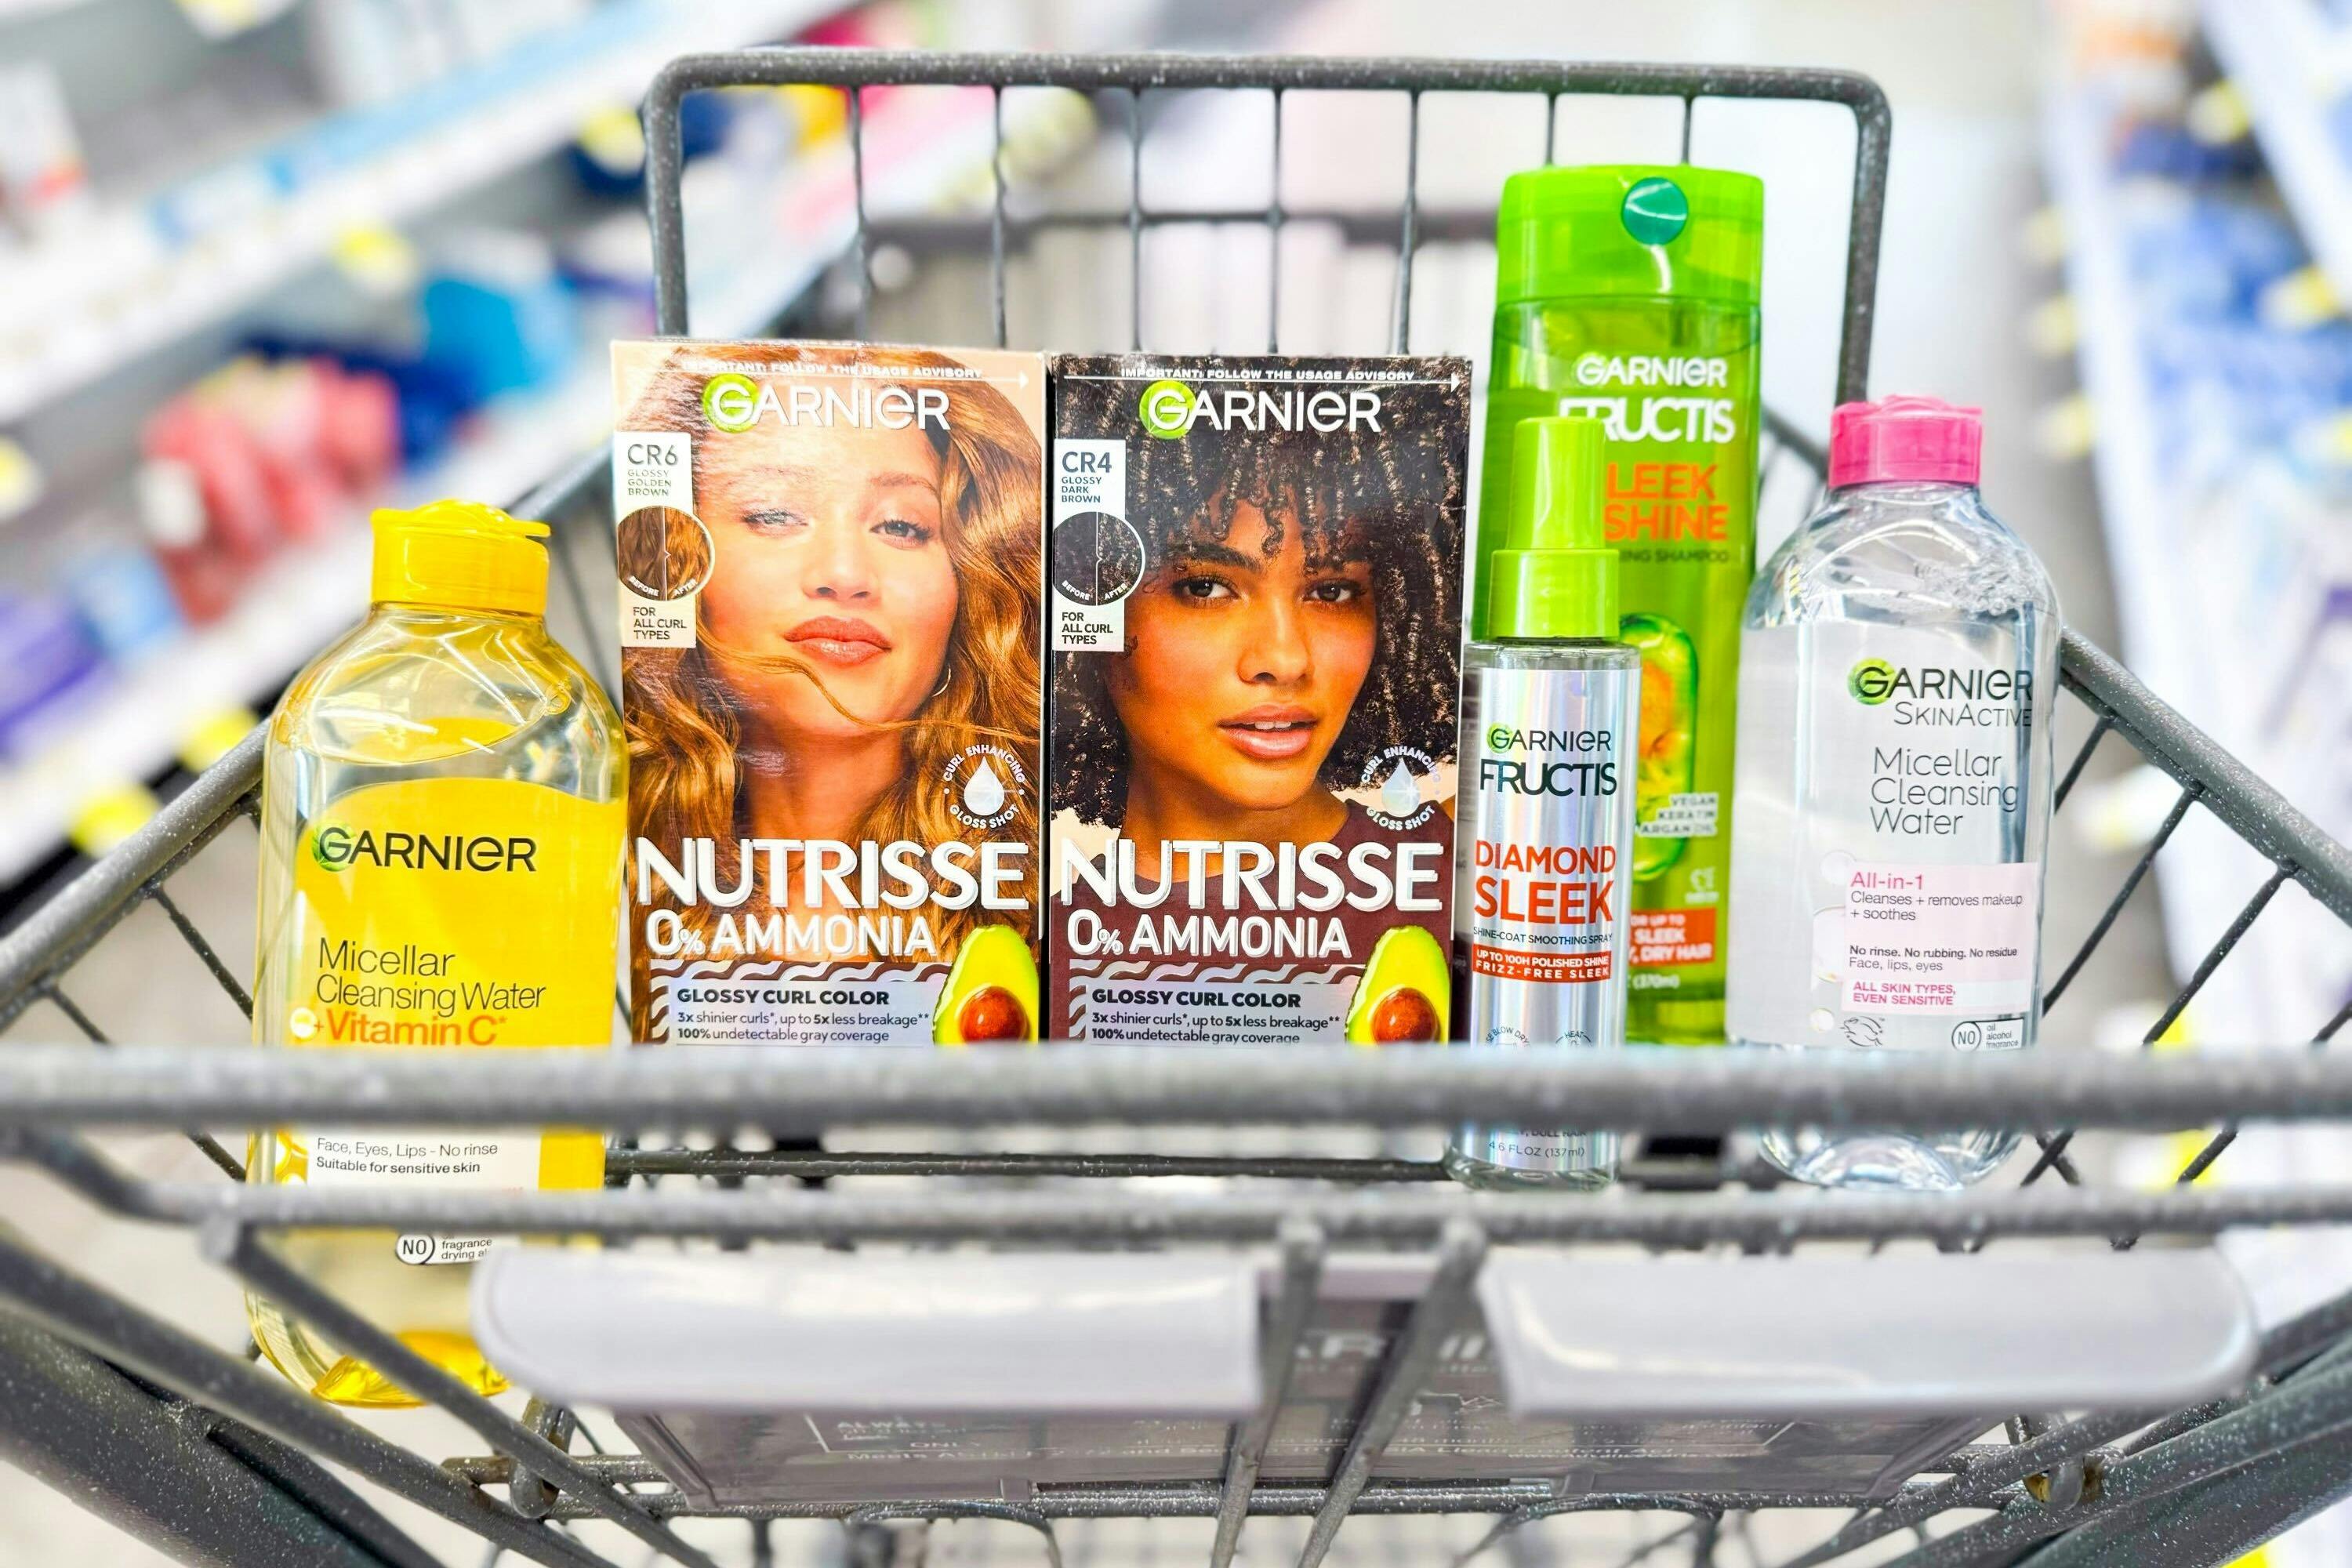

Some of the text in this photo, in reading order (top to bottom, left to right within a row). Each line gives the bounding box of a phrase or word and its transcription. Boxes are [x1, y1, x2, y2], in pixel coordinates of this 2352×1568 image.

[771, 362, 827, 374] FOLLOW
[832, 364, 858, 376] THE
[862, 365, 909, 377] USAGE
[913, 367, 982, 379] ADVISORY
[1207, 369, 1261, 379] FOLLOW
[1265, 370, 1292, 379] THE
[1296, 370, 1342, 379] USAGE
[1345, 371, 1414, 380] ADVISORY
[1577, 356, 1727, 387] GARNIER
[712, 383, 951, 430] GARNIER
[1149, 390, 1381, 433] GARNIER
[627, 444, 678, 466] CR6
[1062, 452, 1112, 474] CR4
[627, 469, 670, 477] GLOSSY
[1062, 476, 1102, 485] GLOSSY
[1607, 463, 1718, 500] LEEK
[627, 478, 672, 487] GOLDEN
[1062, 485, 1089, 494] DARK
[628, 488, 669, 496] BROWN
[1062, 495, 1101, 503] BROWN
[1605, 503, 1728, 541] SHINE
[628, 575, 659, 597] BEFORE
[673, 579, 697, 596] AFTER
[1062, 580, 1091, 601] BEFORE
[1104, 583, 1128, 601] AFTER
[633, 606, 656, 617] FOR
[1062, 612, 1083, 622] FOR
[633, 618, 687, 629] ALL CURL
[1062, 624, 1113, 633] ALL CURL
[633, 630, 670, 641] TYPES
[1062, 635, 1097, 644] TYPES
[1857, 666, 2032, 701] GARNIER
[1490, 728, 1612, 752] GARNIER
[943, 745, 1025, 782] CURL ENHANCING
[1361, 755, 1383, 783] CURL
[1874, 746, 2002, 776] Micellar
[1480, 758, 1617, 797] FRUCTIS
[1871, 777, 2019, 813] Cleansing
[949, 803, 1019, 829] GLOSS SHOT
[1367, 805, 1436, 831] GLOSS SHOT
[1870, 806, 1963, 835] Water
[319, 827, 536, 872] GARNIER
[1475, 840, 1616, 875] DIAMOND
[636, 837, 1029, 910] NUTRISSE
[1061, 837, 1444, 911] NUTRISSE
[1850, 871, 1925, 890] All-in-1
[1474, 875, 1614, 924] SLEEK
[1850, 891, 2023, 907] Cleanses removes makeup
[1850, 908, 1916, 920] + soothes
[645, 909, 938, 956] 0% AMMONIA
[1067, 908, 1352, 957] 0% AMMONIA
[1473, 926, 1613, 946] SHINE-COAT SMOOTHING SPRAY
[1635, 927, 1686, 944] SLEEK
[319, 937, 456, 977] Micellar
[1476, 949, 1610, 967] UP TO 100H POLISHED SHINE
[1640, 945, 1675, 962] DRY
[1676, 942, 1713, 961] HAIR
[1849, 945, 2018, 960] No rinse. No rubbing. No residue
[1475, 960, 1563, 978] FRIZZ-FREE
[1570, 966, 1609, 979] SLEEK
[1849, 957, 1943, 973] Face, lips, eyes
[316, 974, 546, 1018] Cleansing Water
[677, 988, 890, 1005] GLOSSY CURL COLOR
[1853, 981, 1956, 995] ALL SKIN TYPES,
[1092, 989, 1301, 1007] GLOSSY CURL COLOR
[1853, 993, 1954, 1006] EVEN SENSITIVE
[326, 1008, 462, 1046] Vitamin
[677, 1012, 694, 1023] 3x
[696, 1012, 738, 1024] shinier
[780, 1015, 796, 1028] up
[798, 1014, 811, 1025] to
[814, 1014, 830, 1024] 5x
[831, 1014, 856, 1025] less
[1091, 1012, 1109, 1023] 3x
[1110, 1012, 1151, 1025] shinier
[1192, 1018, 1208, 1029] up
[1210, 1015, 1223, 1026] to
[1225, 1016, 1242, 1026] 5x
[1243, 1015, 1267, 1027] less
[1987, 1023, 1995, 1032] oil
[678, 1028, 889, 1044] 100% undetectable gray coverage
[1092, 1028, 1300, 1044] 100% undetectable gray coverage
[1493, 1025, 1514, 1036] BLOW
[1958, 1030, 1976, 1044] NO
[1986, 1031, 2012, 1040] alcohol
[317, 1138, 499, 1159] Face, Eyes, Lips No rinse
[316, 1156, 481, 1174] Suitable for sensitive skin
[402, 1239, 426, 1255] NO
[441, 1238, 492, 1251] fragrance
[441, 1250, 475, 1261] drying
